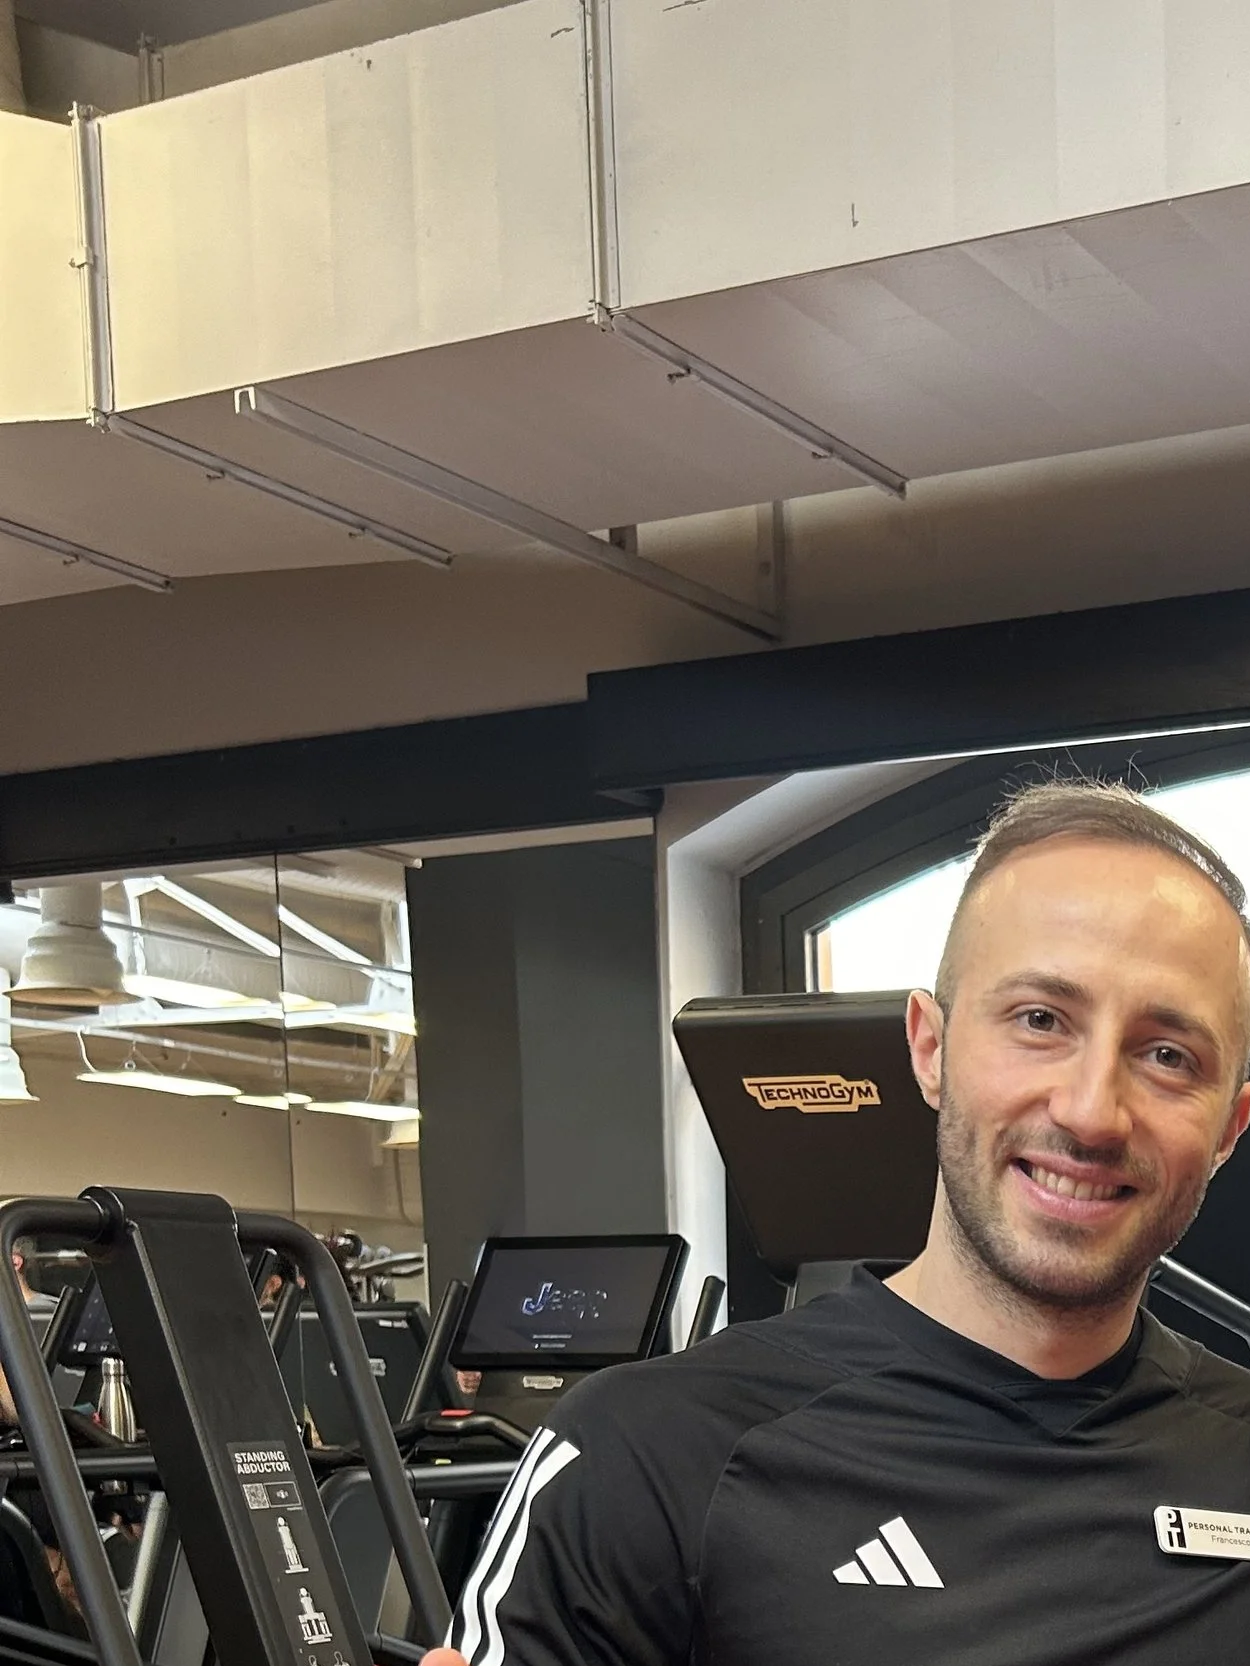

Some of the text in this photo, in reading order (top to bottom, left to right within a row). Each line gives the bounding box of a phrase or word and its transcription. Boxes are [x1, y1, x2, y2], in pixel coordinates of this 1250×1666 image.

[234, 1450, 286, 1464] STANDING
[237, 1461, 291, 1475] ABDUCTOR
[1188, 1521, 1233, 1534] PERSONAL
